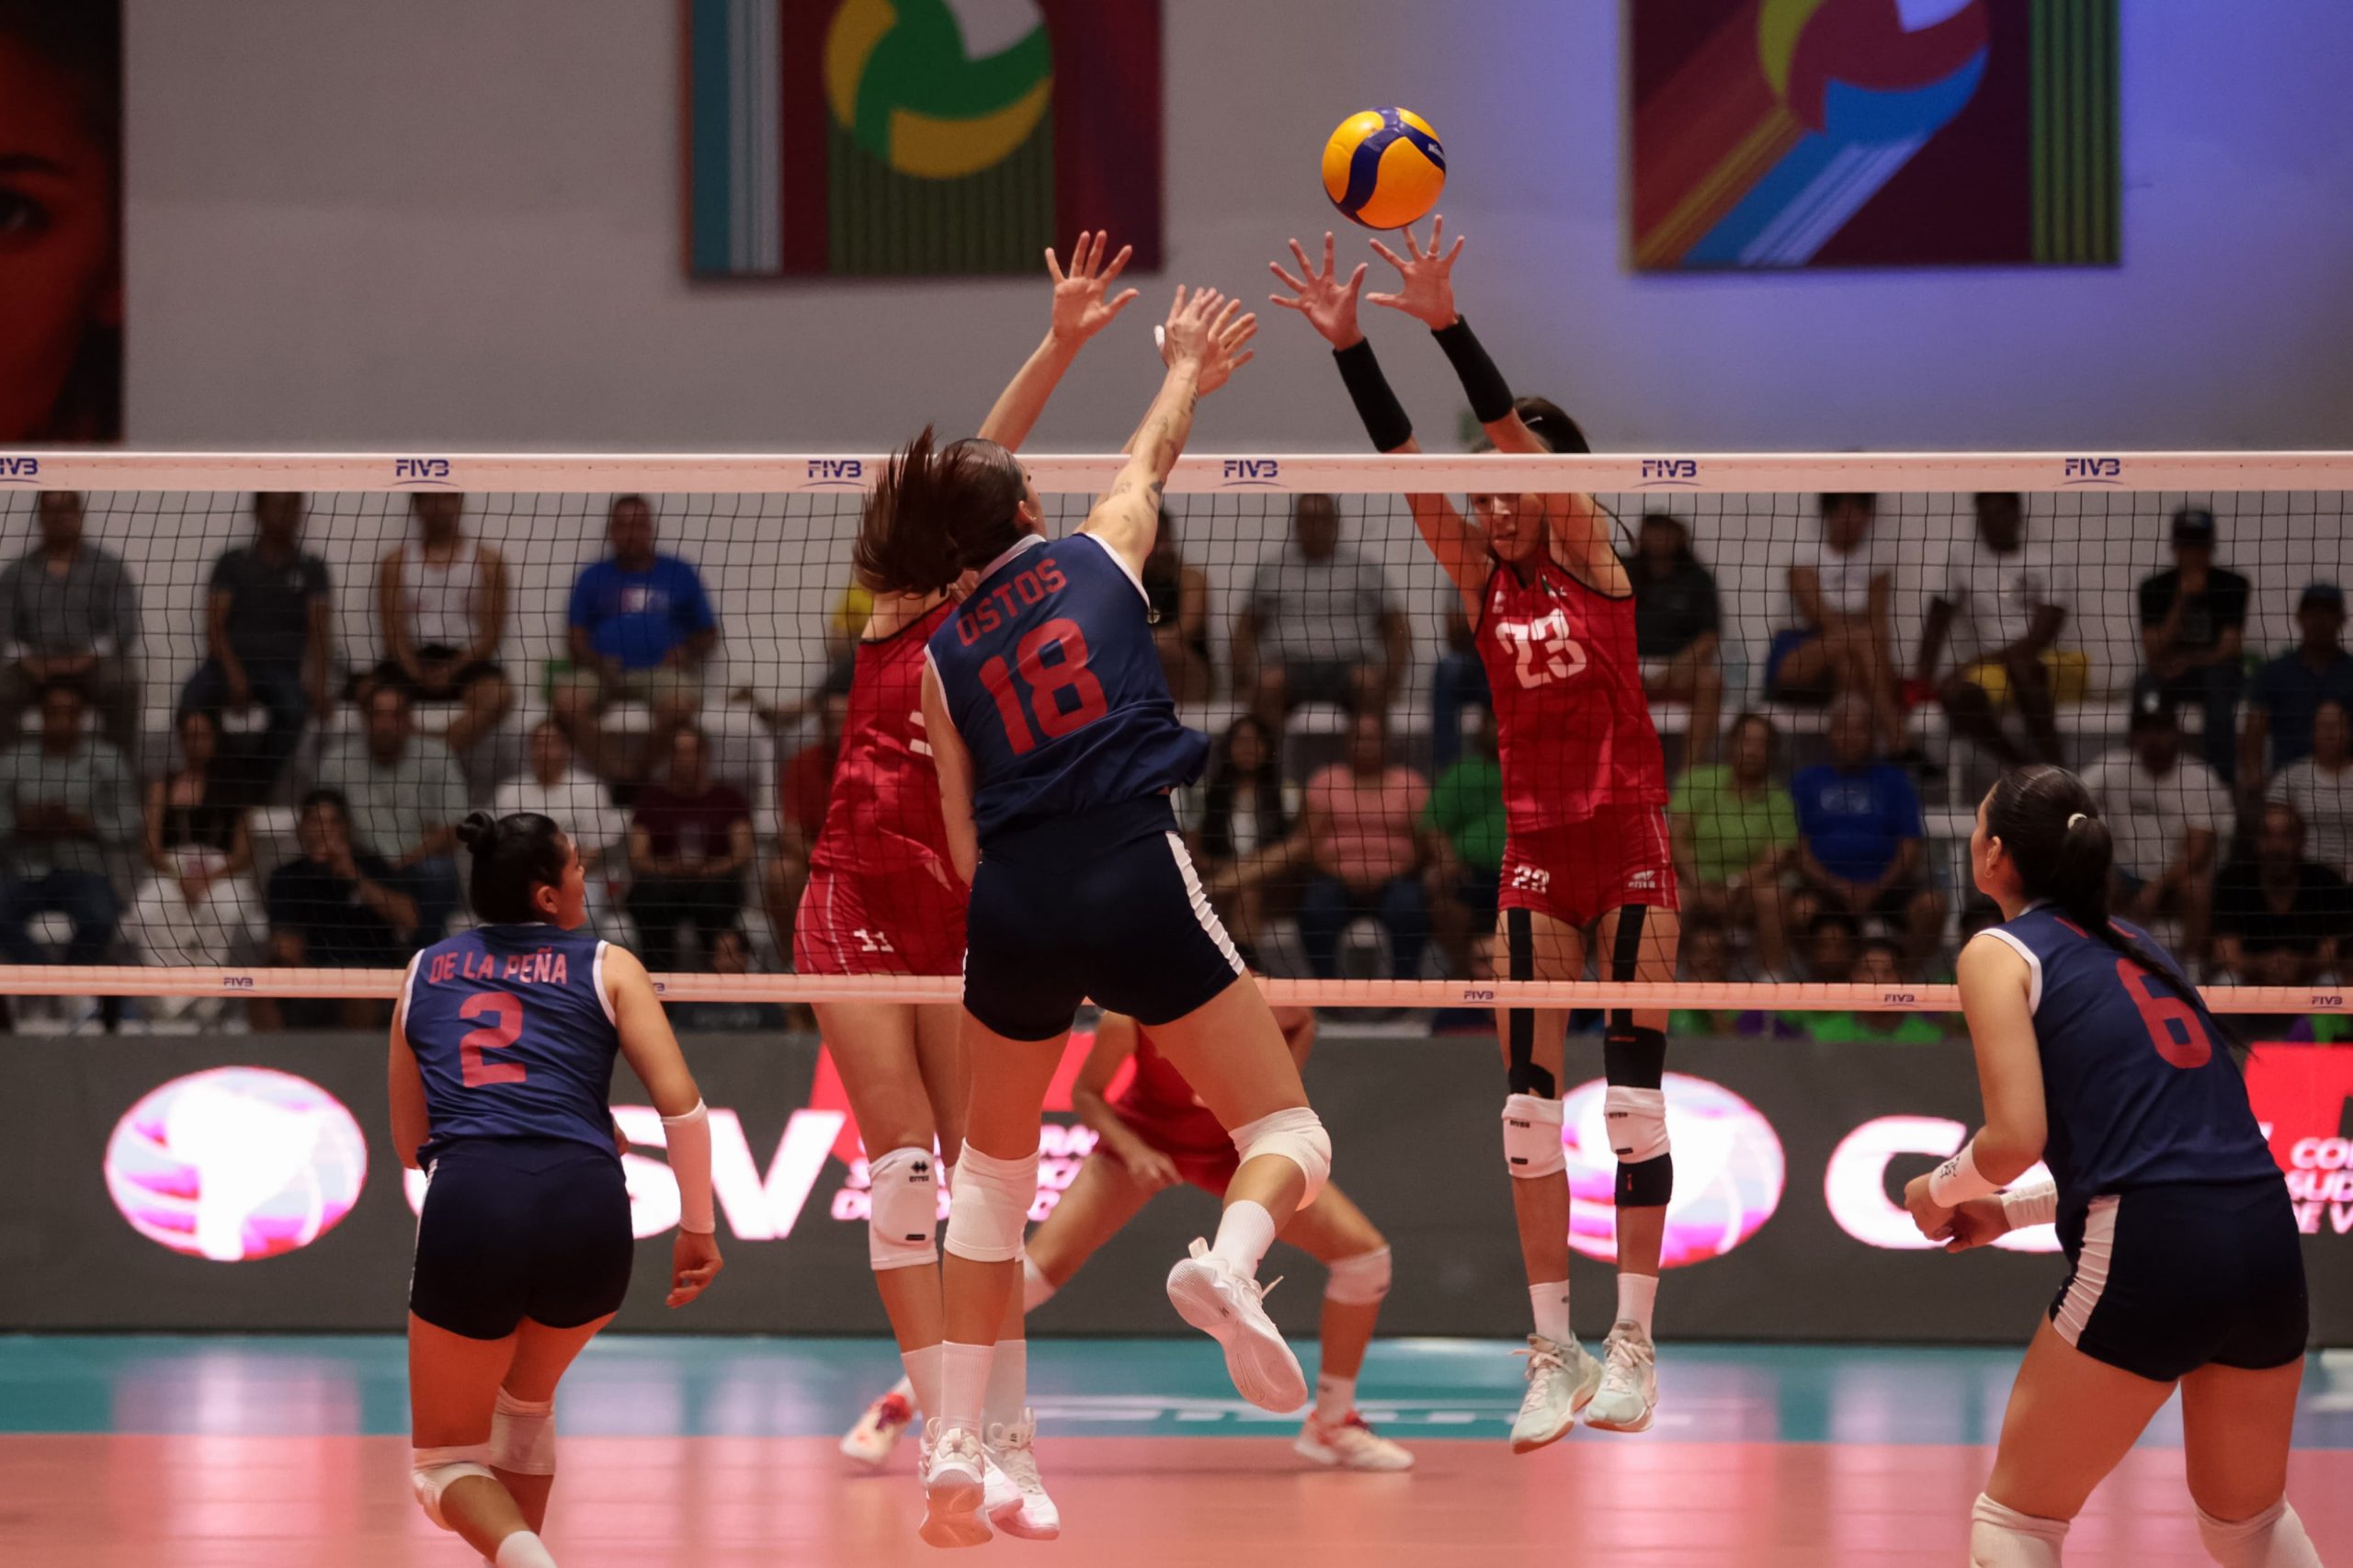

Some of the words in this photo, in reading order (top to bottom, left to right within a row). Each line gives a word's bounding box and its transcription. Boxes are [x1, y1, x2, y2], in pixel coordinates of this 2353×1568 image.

[0, 458, 39, 476] IVB
[396, 459, 449, 477] FIVB
[808, 460, 862, 479] FIVB
[1224, 460, 1278, 479] FIVB
[1642, 460, 1698, 478] FIVB
[2064, 458, 2120, 477] FIVB
[955, 558, 1068, 647] OSTOS
[1495, 607, 1588, 689] 23
[978, 617, 1108, 756] 18
[428, 952, 459, 985] DE
[462, 951, 494, 980] LA
[502, 946, 568, 986] PEÑA
[223, 977, 254, 988] FIVB
[1463, 990, 1495, 1000] FIVB
[1884, 994, 1915, 1003] FIVB
[2312, 996, 2343, 1006] FIVB
[2116, 958, 2213, 1070] 6
[459, 991, 528, 1088] 2
